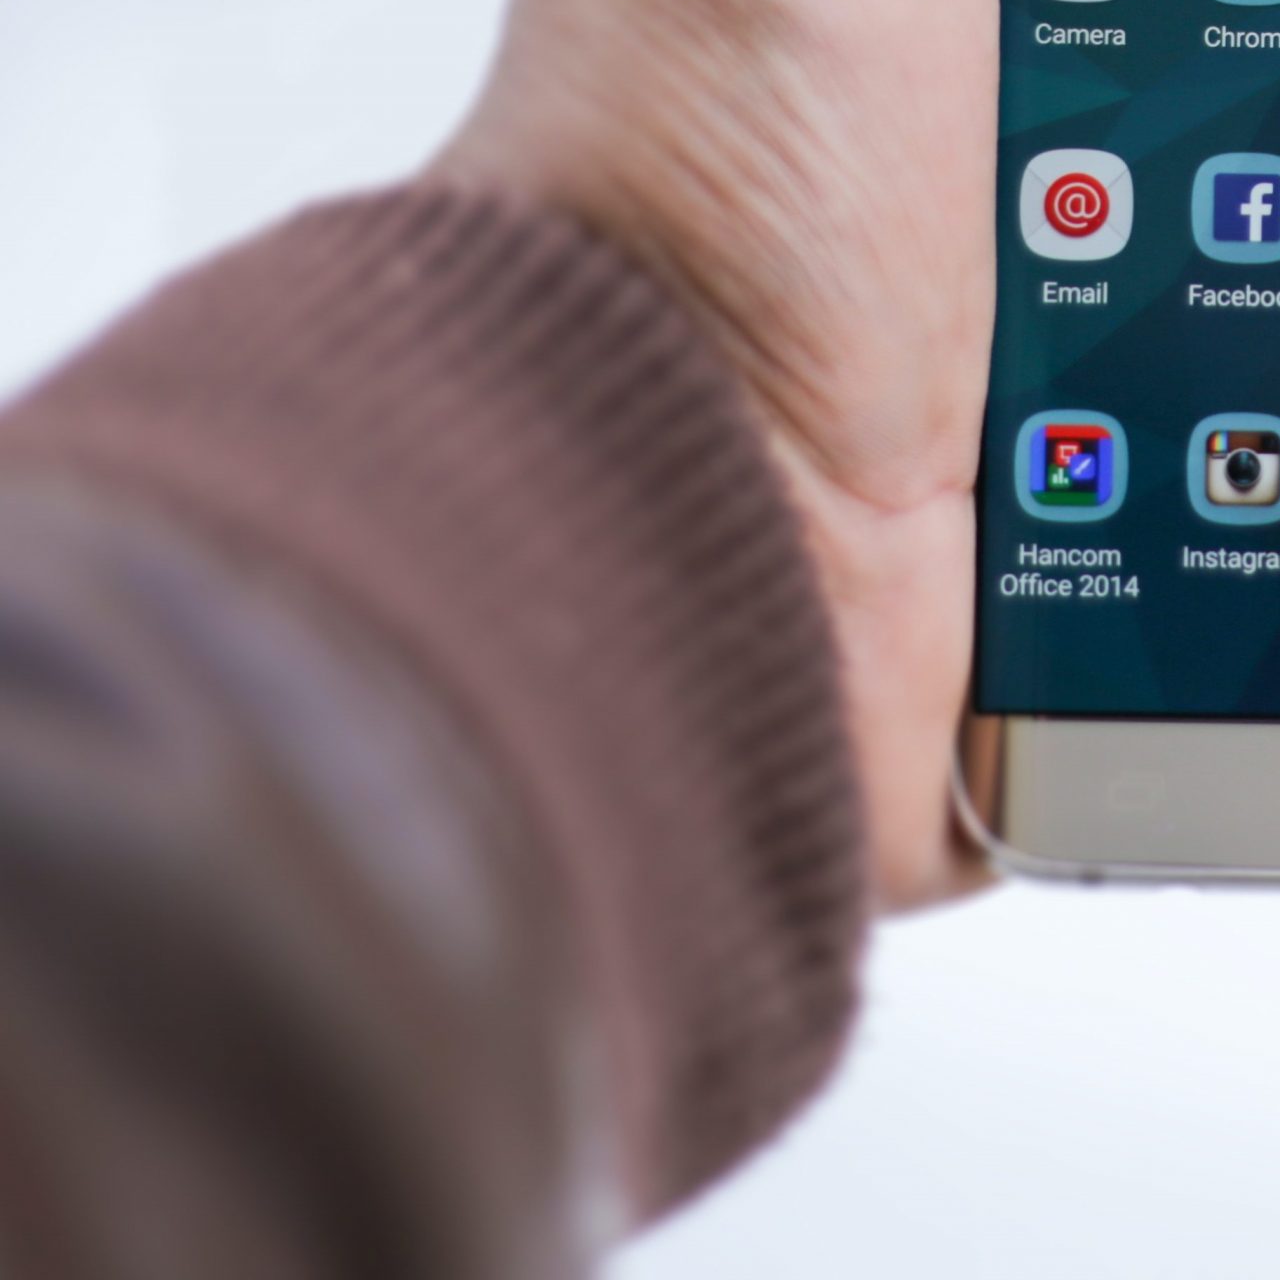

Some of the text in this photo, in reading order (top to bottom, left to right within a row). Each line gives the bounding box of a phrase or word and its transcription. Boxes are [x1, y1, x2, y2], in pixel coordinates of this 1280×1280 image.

[1034, 23, 1126, 45] Camera
[1240, 183, 1274, 242] f
[1042, 282, 1108, 304] Email
[1018, 544, 1121, 566] Hancom
[1000, 573, 1140, 597] Office 2014
